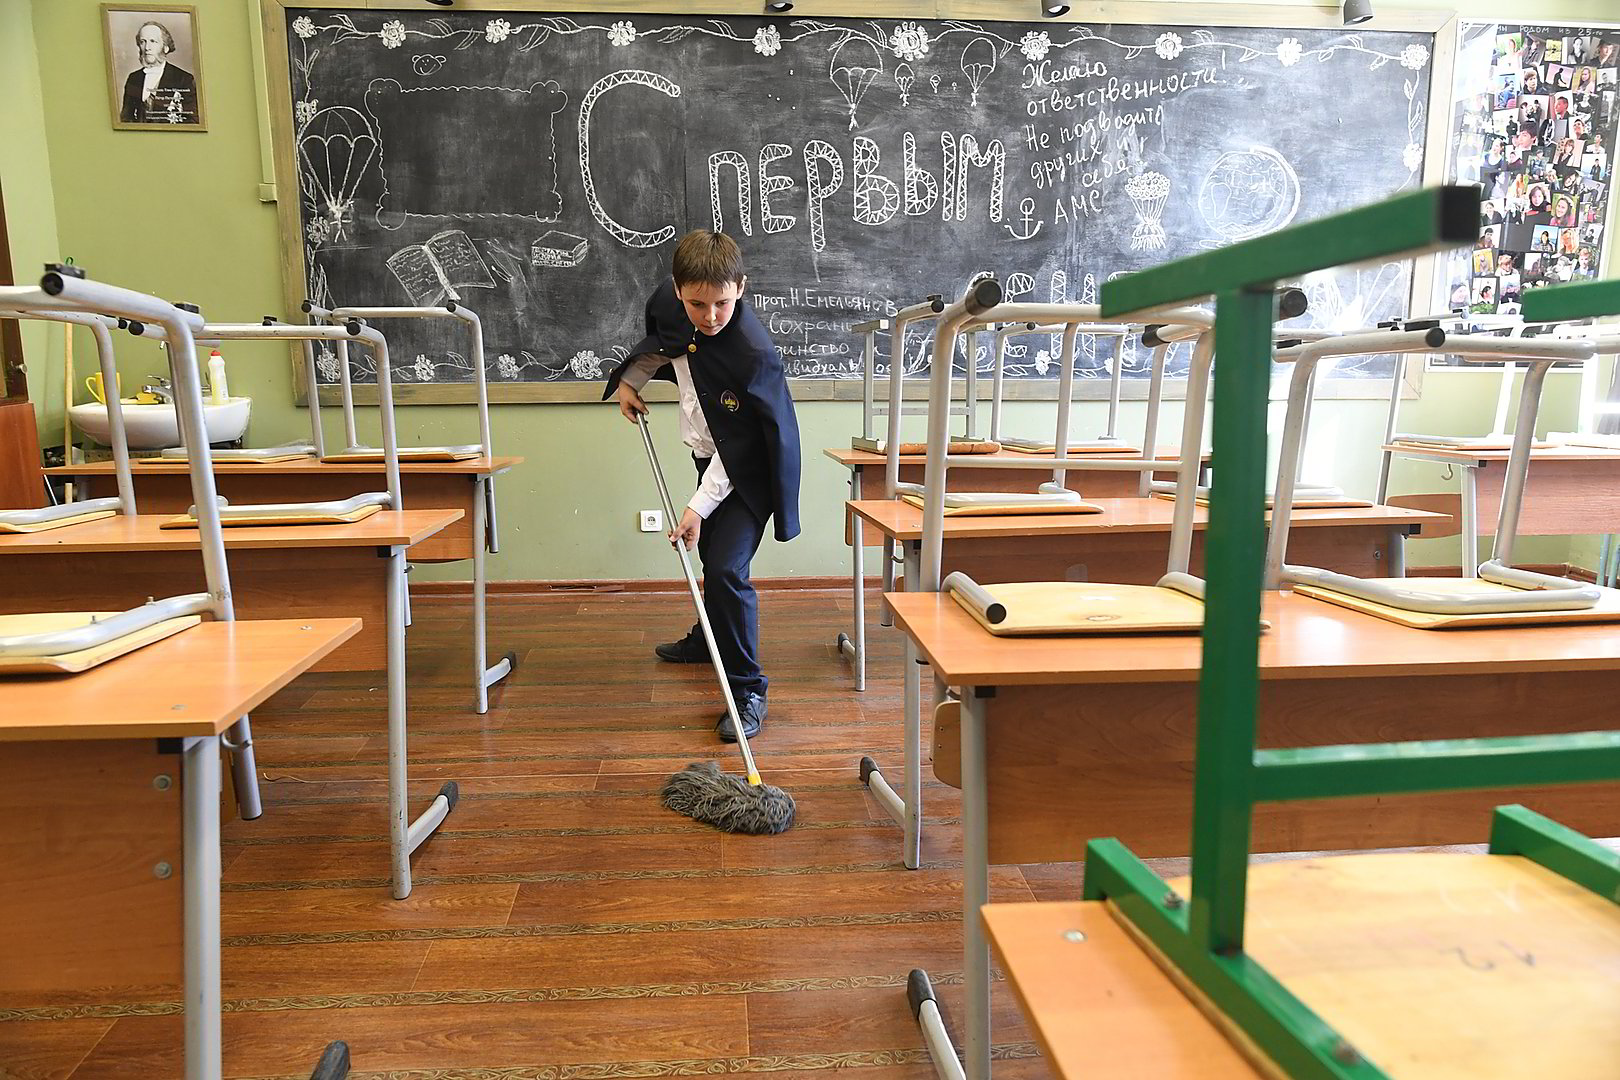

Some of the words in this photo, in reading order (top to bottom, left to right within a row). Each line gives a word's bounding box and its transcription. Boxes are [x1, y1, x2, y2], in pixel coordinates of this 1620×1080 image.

[1022, 60, 1107, 89] Желаю
[1026, 123, 1050, 152] Не
[578, 70, 681, 248] С
[708, 131, 1006, 252] ПЕРВЫМ
[1030, 139, 1102, 189] других
[1054, 189, 1102, 225] АМС
